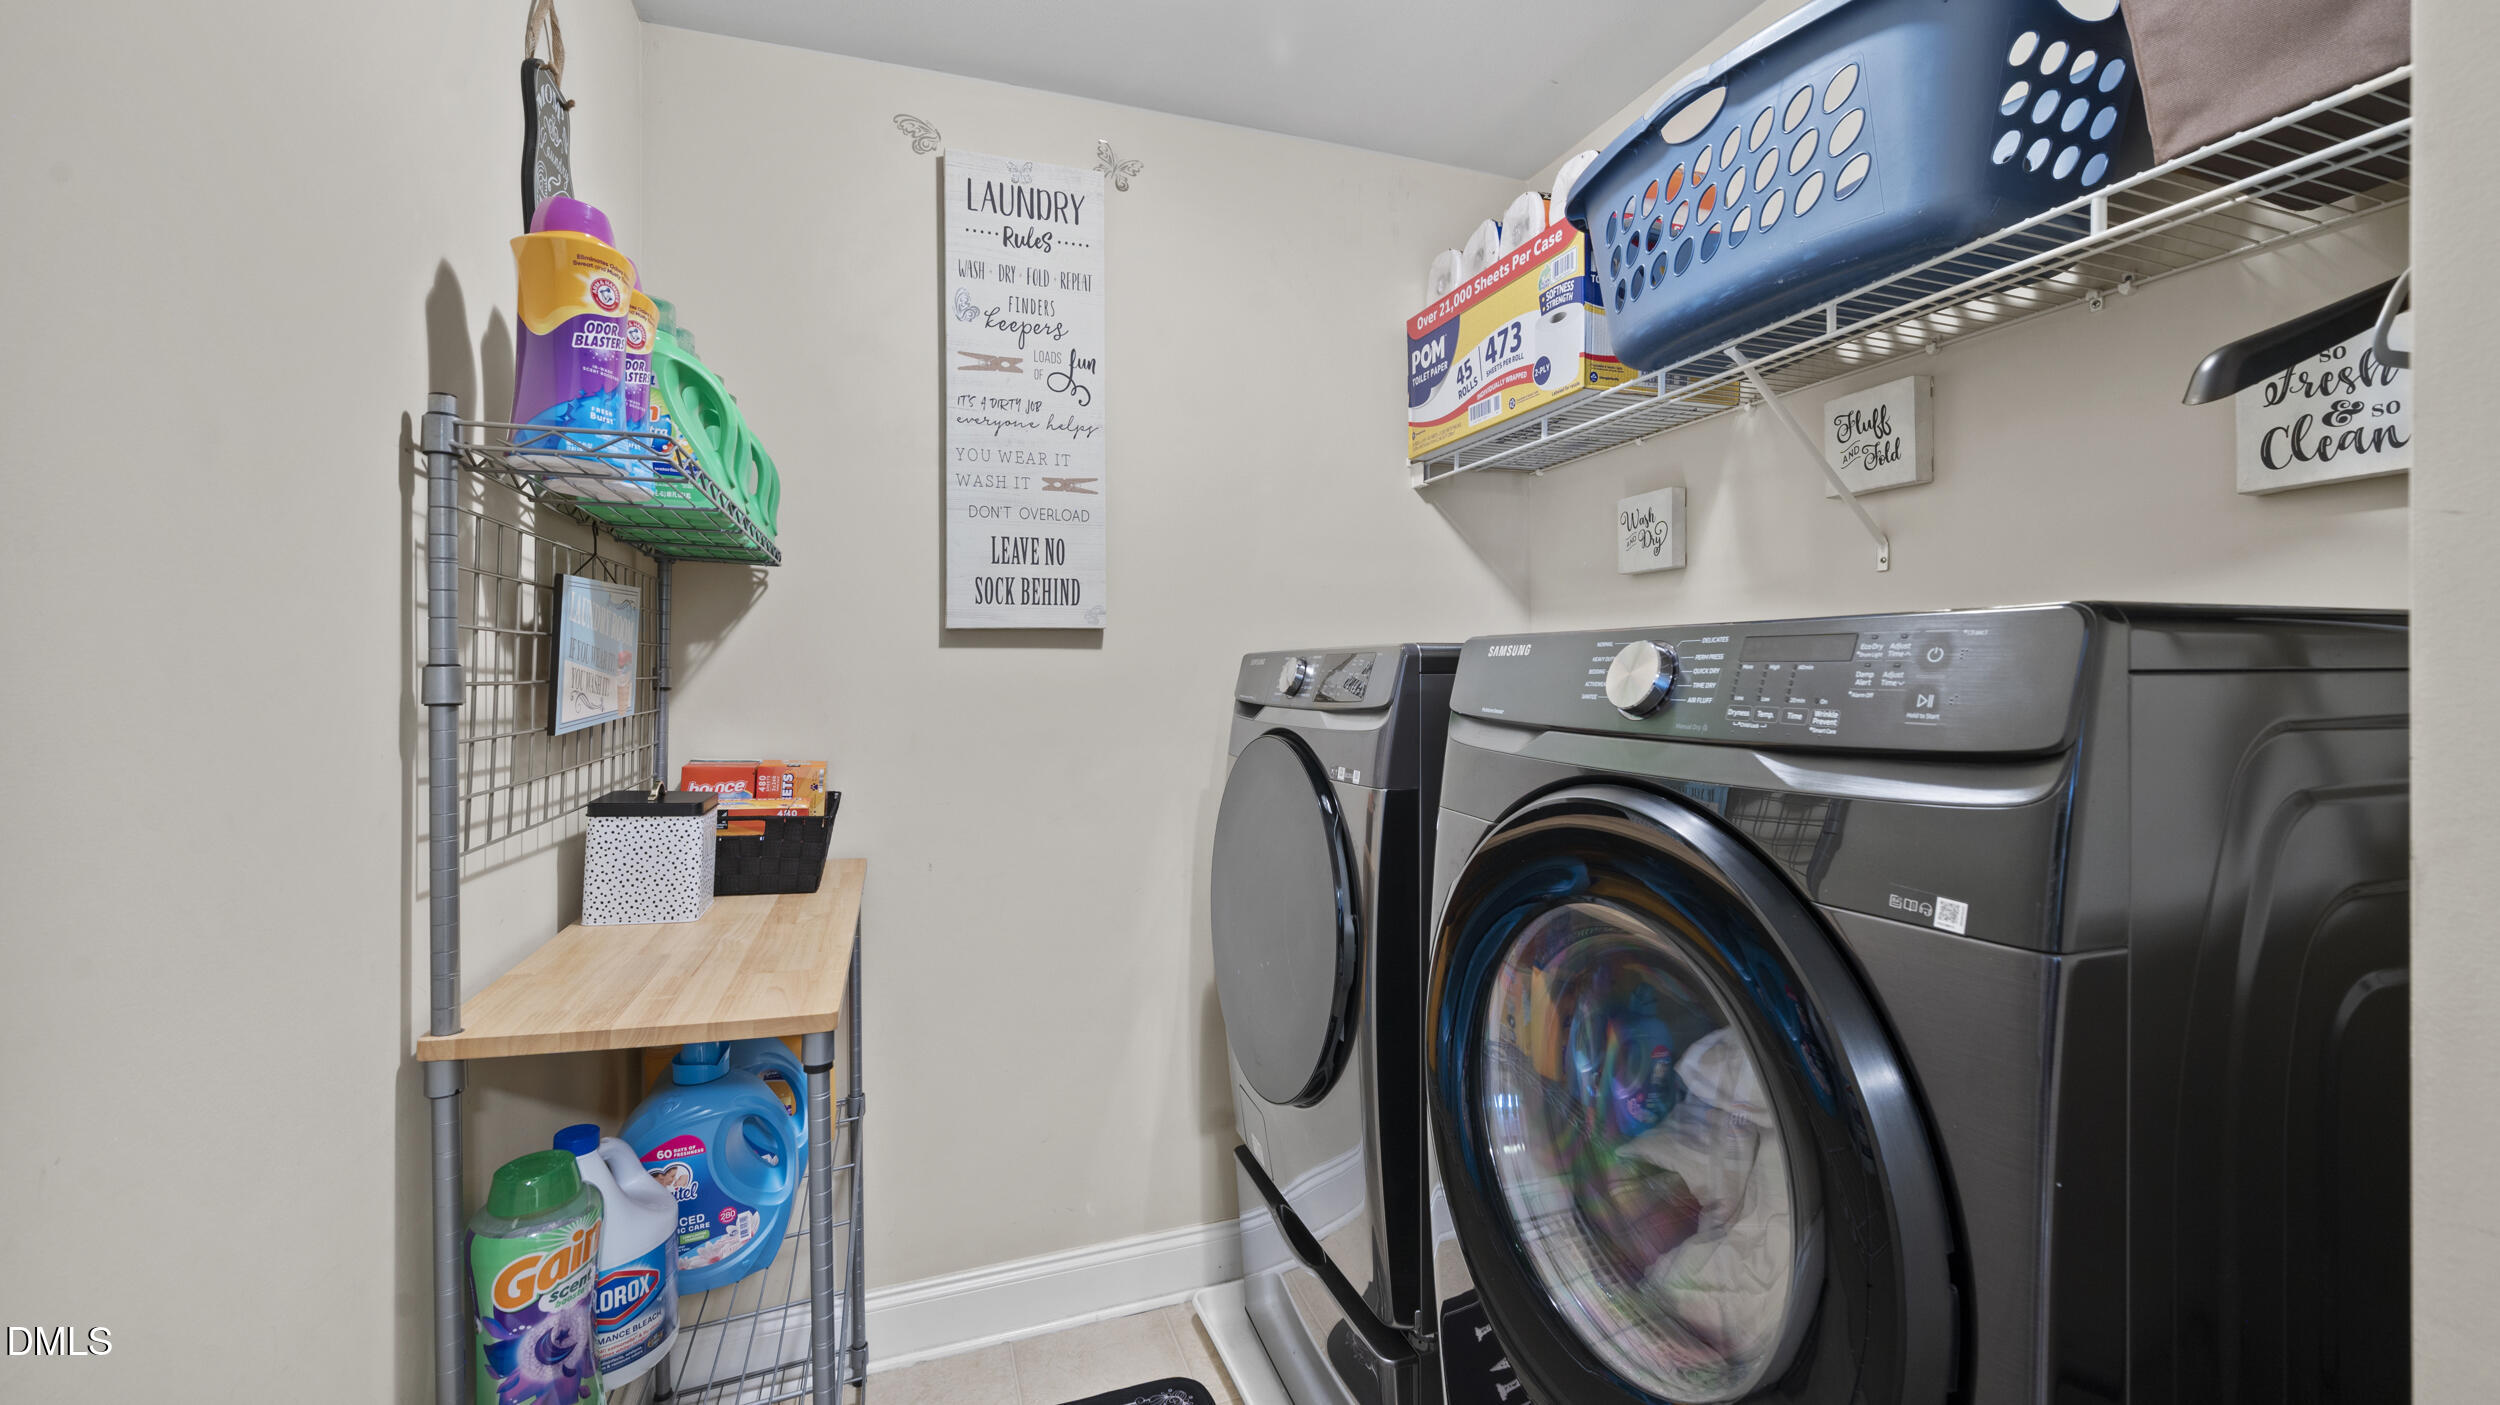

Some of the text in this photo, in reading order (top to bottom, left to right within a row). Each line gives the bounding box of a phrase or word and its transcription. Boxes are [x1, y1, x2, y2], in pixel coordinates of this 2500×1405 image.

[967, 177, 1085, 225] LAUNDRY
[1003, 226, 1053, 253] Rules
[958, 258, 1092, 292] WASH DRY FOLD REPEAT
[1417, 310, 1437, 330] Over
[1439, 287, 1472, 318] 21,000
[1474, 263, 1510, 295] Sheets
[1512, 252, 1530, 270] Per
[1534, 229, 1563, 256] Case
[1546, 280, 1575, 301] SOFTNESS
[1546, 291, 1574, 311] STRENGTH
[1008, 296, 1055, 317] FINDERS
[586, 322, 618, 336] ODOR
[574, 334, 625, 350] BLASTERS
[1411, 335, 1445, 374] POM
[1485, 321, 1522, 364] 473
[625, 360, 645, 371] DOR
[1033, 350, 1062, 364] LOADS
[1486, 352, 1524, 378] SHEETS PER ROLL
[1034, 369, 1044, 380] OF
[1412, 361, 1449, 388] TOILET PAPER
[1456, 358, 1473, 386] 45
[1534, 364, 1551, 377] 2-PLY
[2263, 346, 2400, 408] Fresh
[1458, 377, 1478, 400] ROLLS
[1476, 378, 1505, 400] INDIVIDUALLY
[1505, 371, 1528, 387] WRAPPED
[957, 394, 1042, 414] IT'S A DIRTY JOB
[2322, 399, 2365, 427] &
[590, 412, 613, 425] Burst
[956, 414, 1100, 440] everyone helps
[1834, 404, 1892, 443] Fluff
[1842, 437, 1902, 471] AND Fold
[2260, 413, 2411, 470] Clean
[956, 447, 1071, 467] YOU WEAR IT
[955, 473, 1030, 490] WASH IT
[968, 504, 1090, 522] DON'T OVERLOAD
[1619, 507, 1655, 533] Wash
[991, 536, 1065, 566] LEAVE NO
[1627, 520, 1668, 557] AND Dry
[975, 576, 1081, 606] SOCK BEHIND
[1488, 644, 1532, 657] SAMSUNG
[1889, 643, 1912, 651] Adjust
[1855, 671, 1904, 679] Damp Adjust
[758, 776, 767, 792] 480
[656, 1150, 673, 1160] 60
[688, 1222, 711, 1233] CARE
[491, 1220, 600, 1312] Gain
[549, 1268, 592, 1303] scent
[632, 1309, 662, 1333] BLEACH
